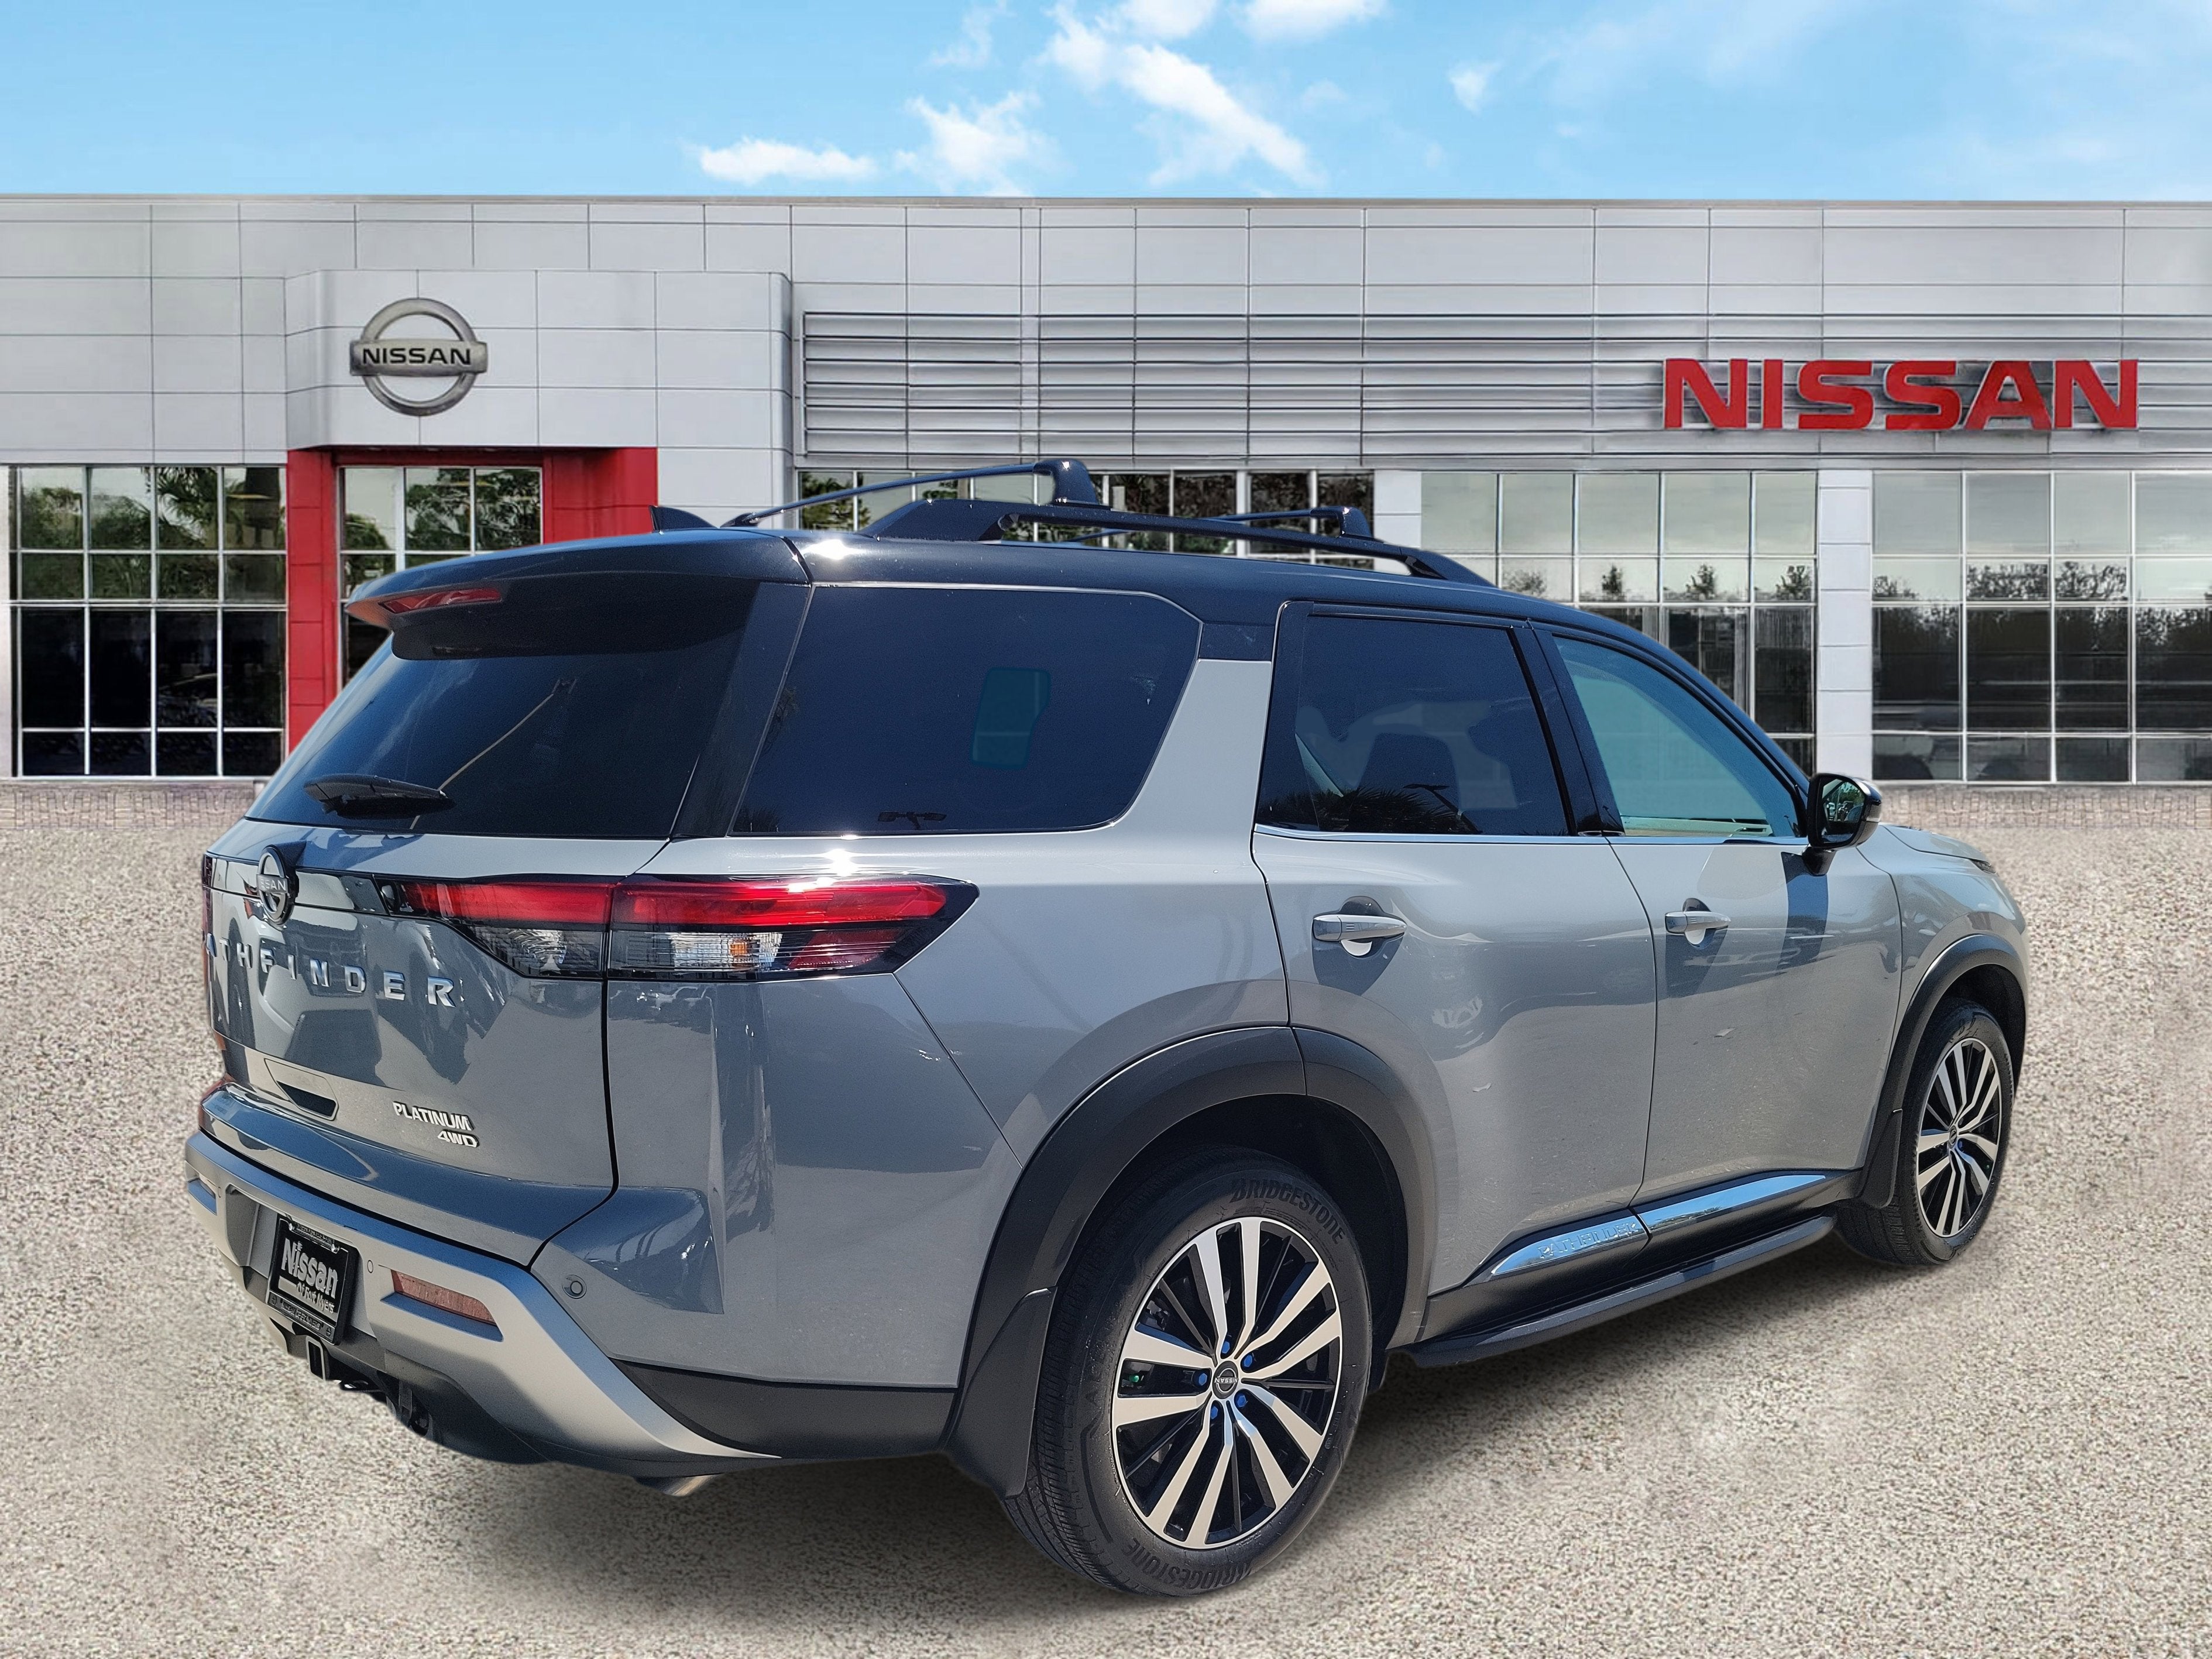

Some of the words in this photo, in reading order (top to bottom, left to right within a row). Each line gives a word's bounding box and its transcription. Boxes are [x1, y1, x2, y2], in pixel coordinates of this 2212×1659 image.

[363, 348, 470, 365] NISSAN
[1663, 358, 2139, 431] NISSAN
[207, 933, 456, 1008] ATHFINDER
[393, 1101, 475, 1131] PLATINUM
[438, 1129, 479, 1148] 4WD
[1229, 1179, 1345, 1245] BRIDGESTONE
[281, 1237, 338, 1299] Nissan
